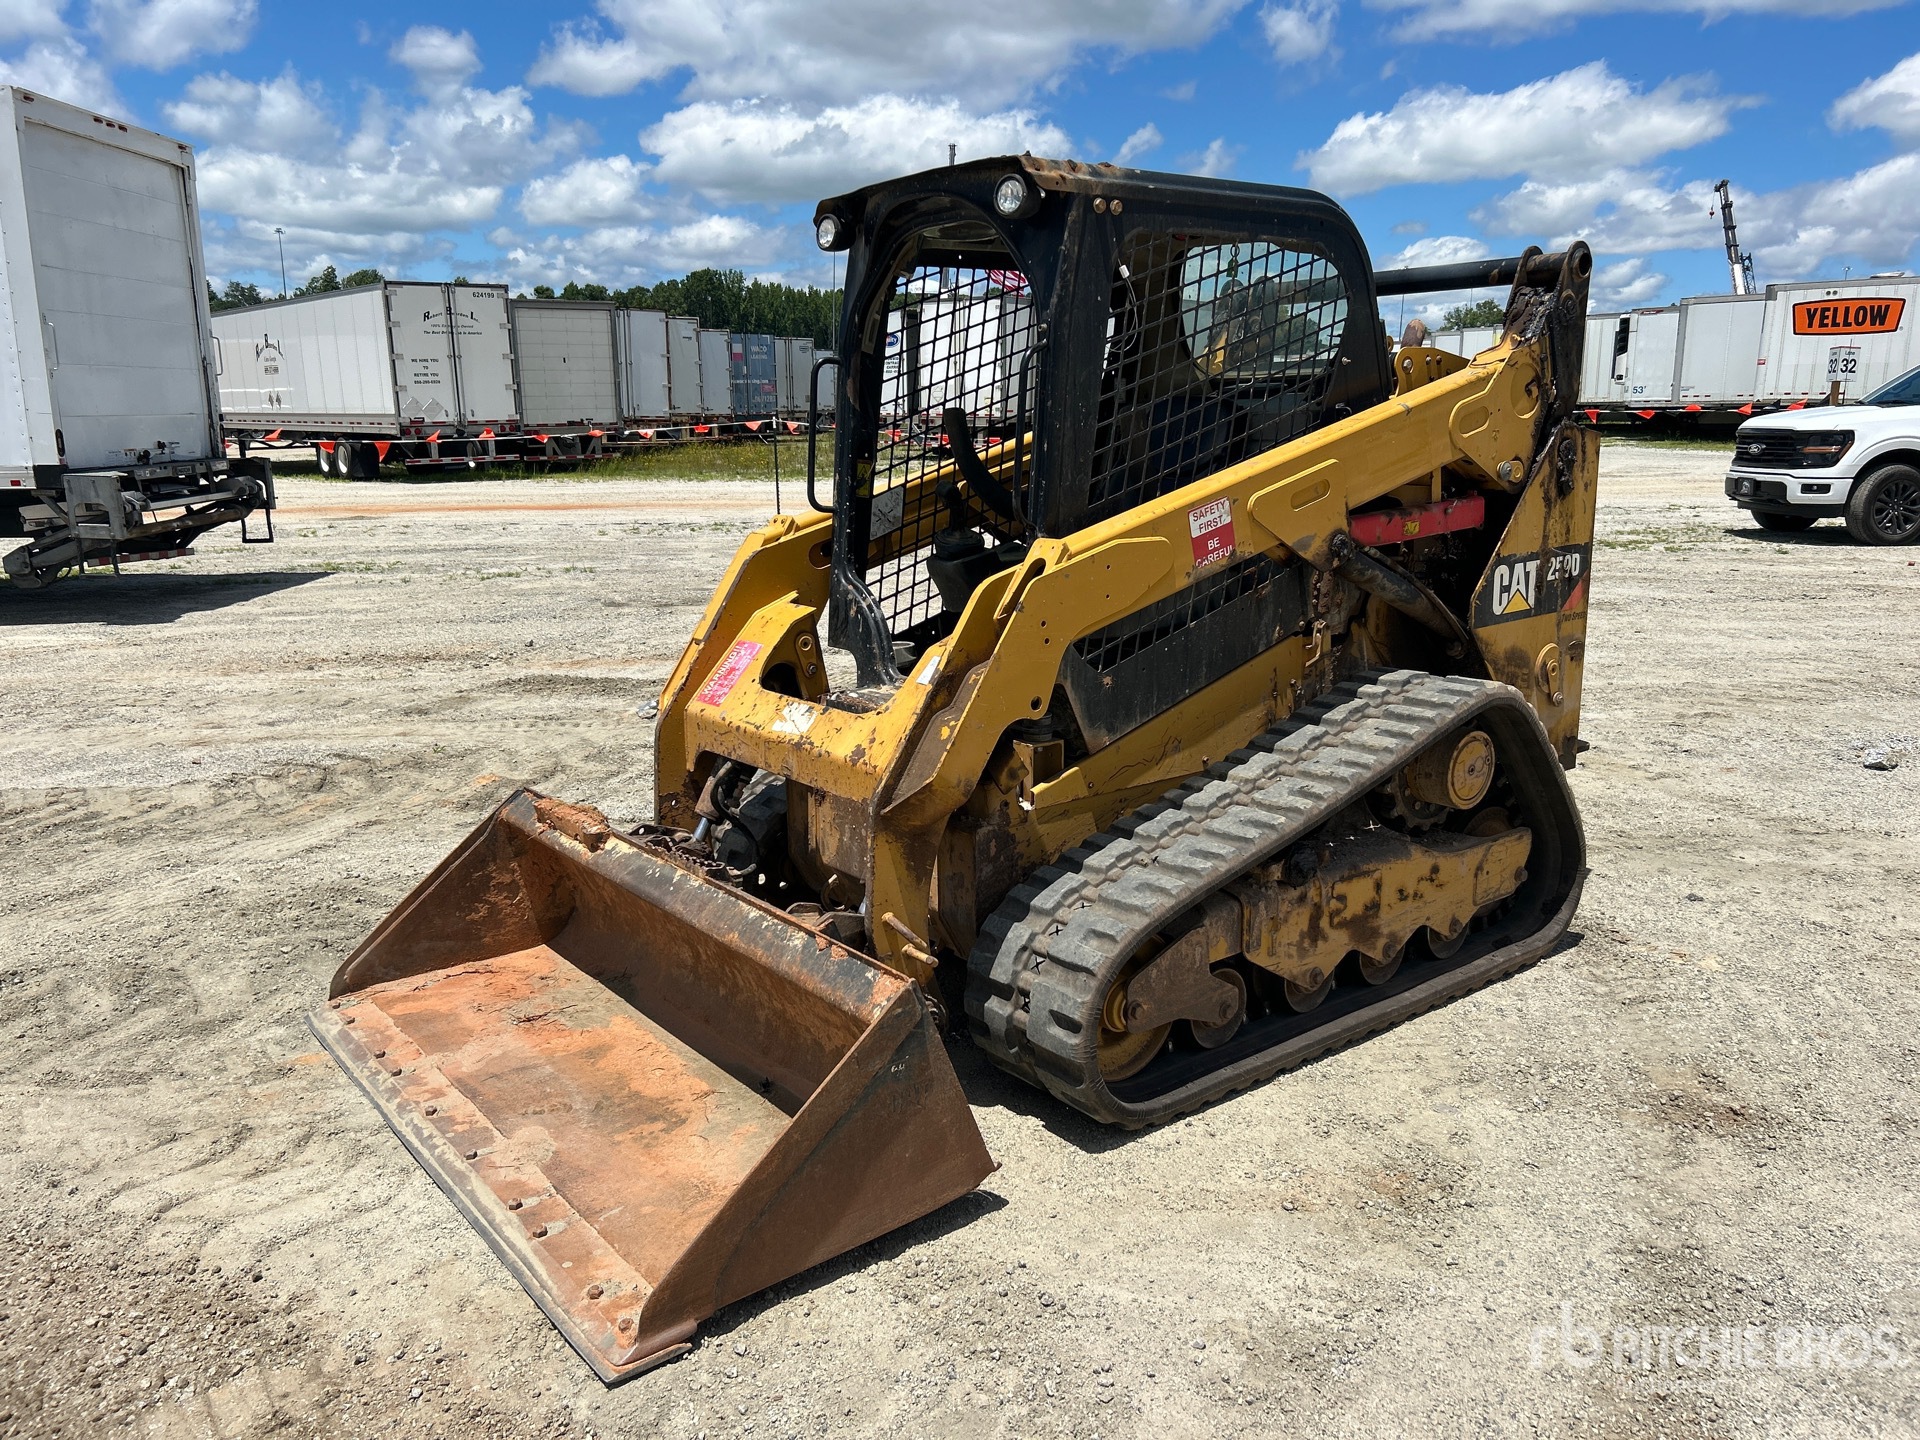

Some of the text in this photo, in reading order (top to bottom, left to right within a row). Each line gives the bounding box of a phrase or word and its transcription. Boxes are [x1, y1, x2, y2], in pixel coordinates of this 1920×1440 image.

[472, 291, 495, 299] 624199
[1806, 304, 1890, 329] YELLOW
[1828, 358, 1838, 374] 32
[1840, 358, 1857, 374] 32
[1193, 500, 1226, 522] SAFETY
[1198, 515, 1223, 533] FIRST
[1207, 537, 1220, 551] BE
[1492, 558, 1540, 616] CAT
